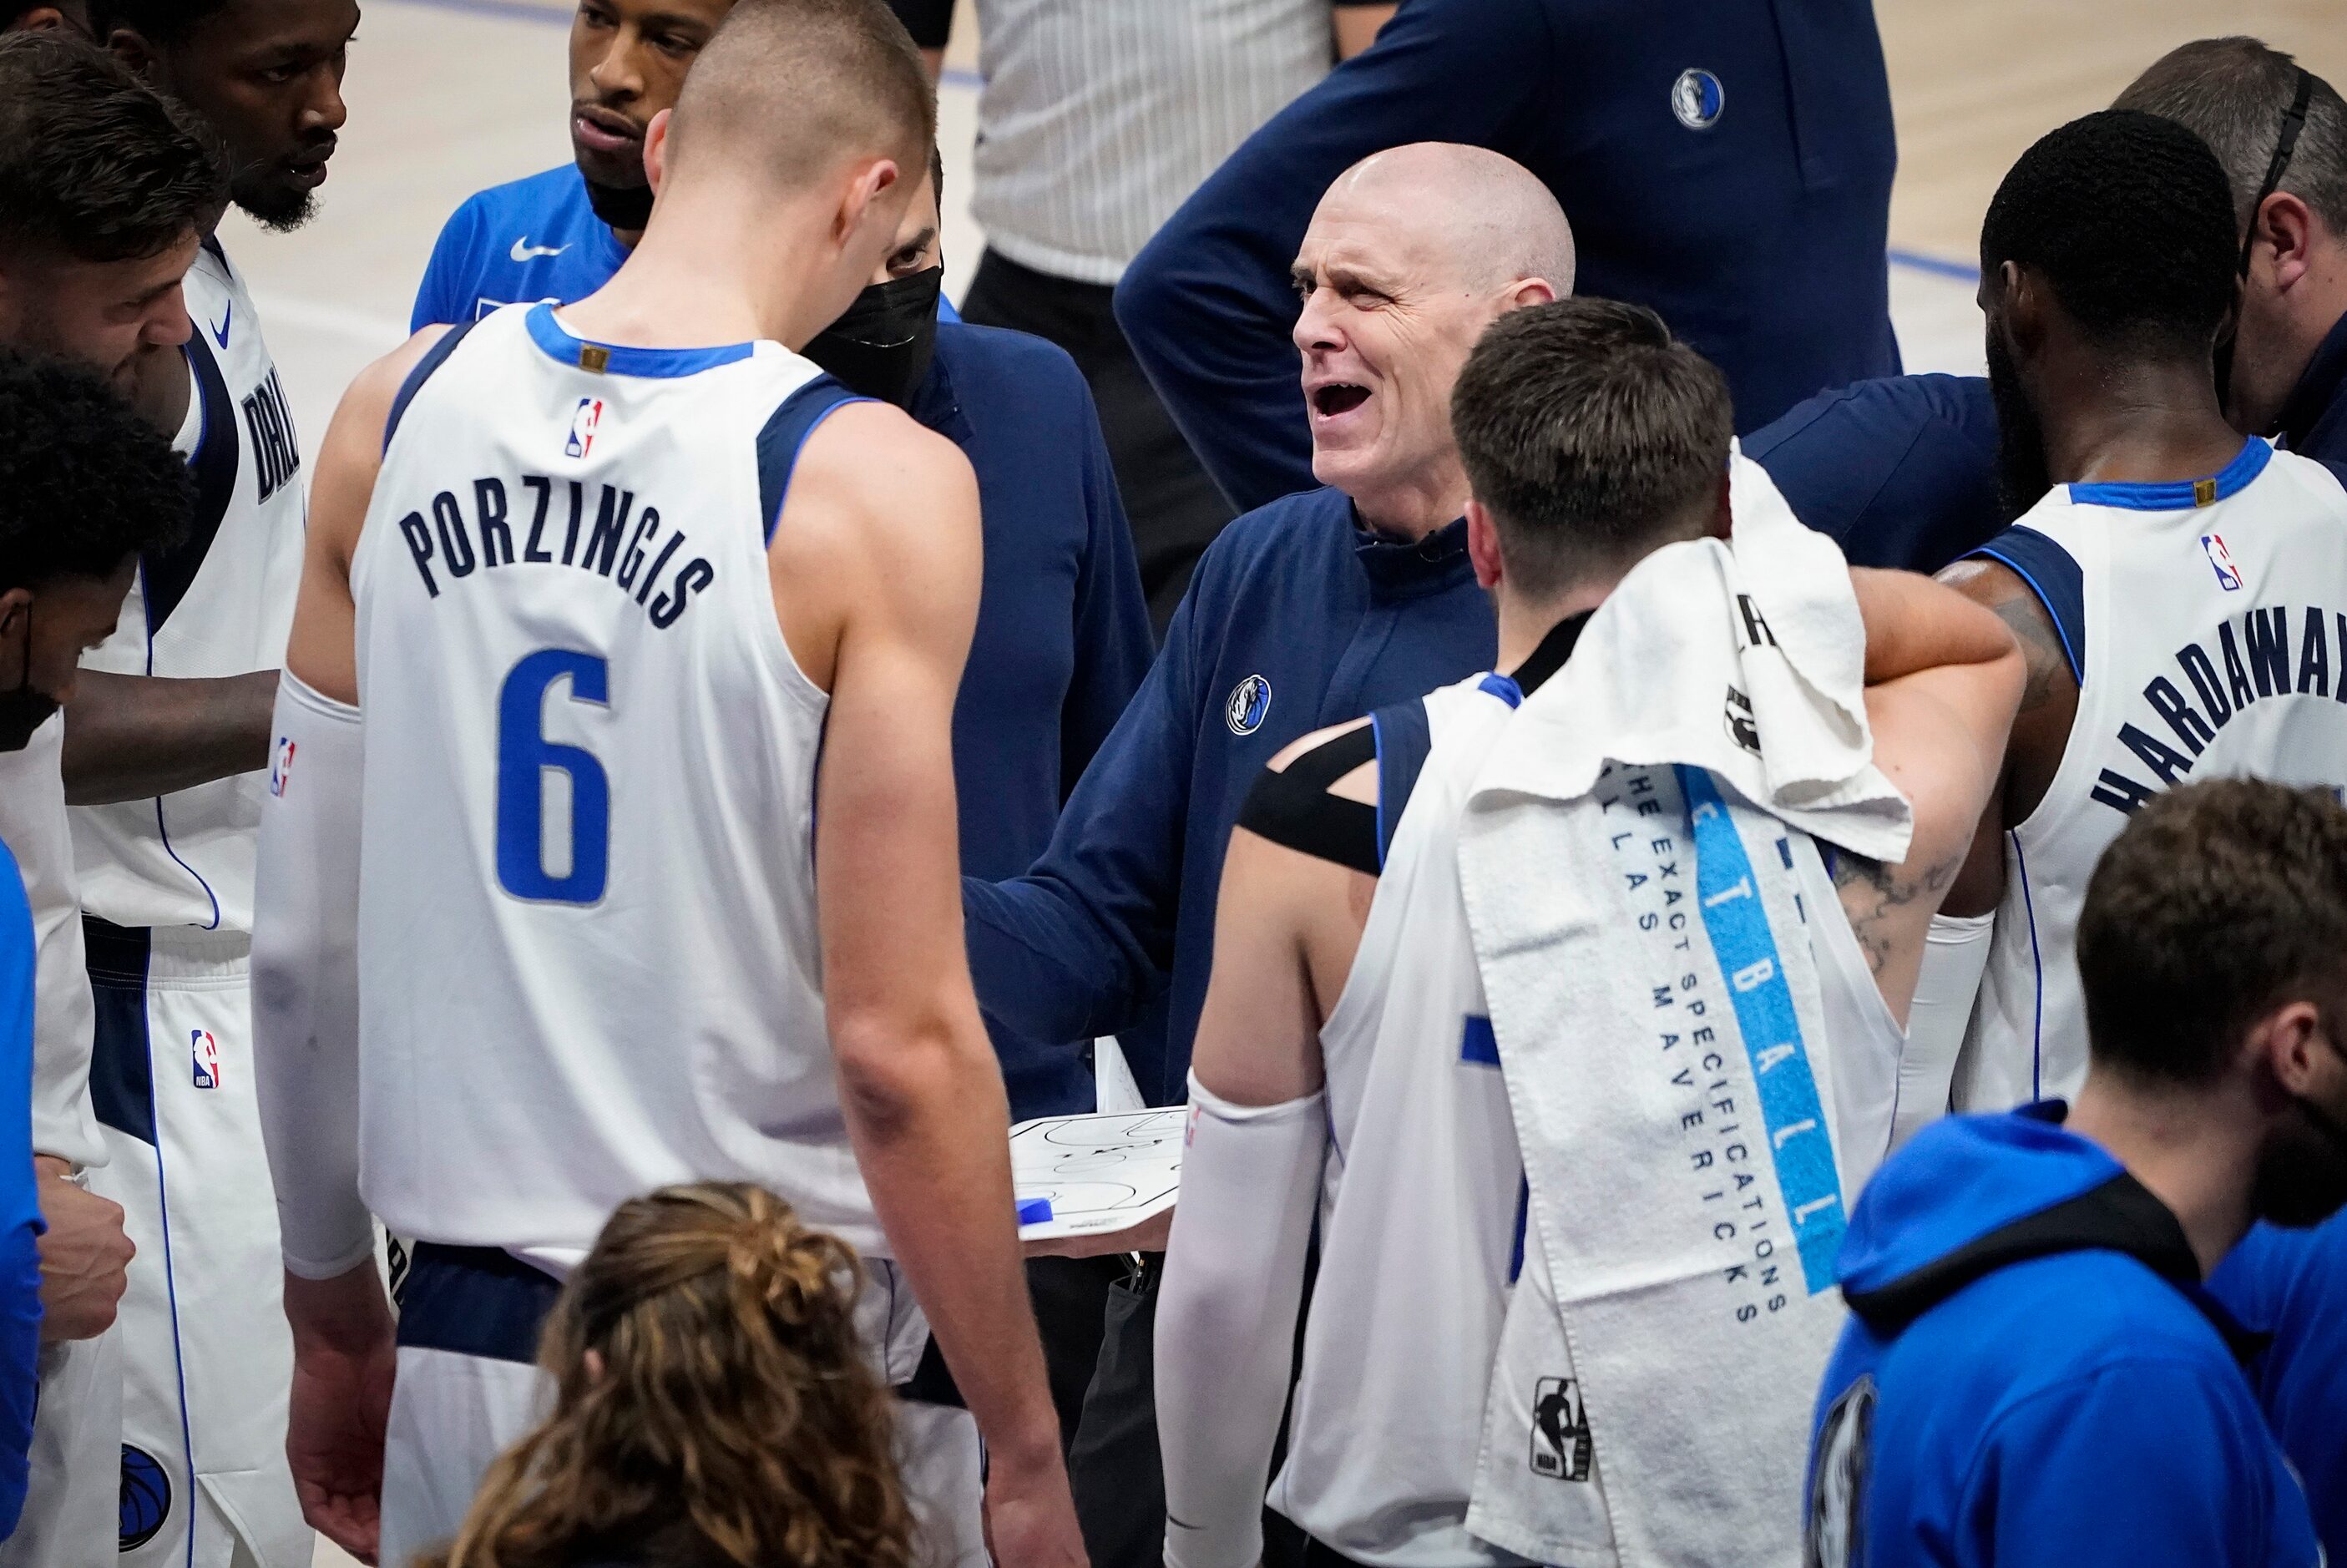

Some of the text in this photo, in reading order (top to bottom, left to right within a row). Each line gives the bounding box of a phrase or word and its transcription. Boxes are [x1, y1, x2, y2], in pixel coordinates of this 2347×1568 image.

[399, 474, 715, 630] PORZINGIS
[494, 647, 611, 909] 6
[2090, 605, 2347, 815] HARDAWA
[195, 1075, 210, 1086] NBA
[1623, 764, 1787, 1313] HE EXACT SPECIFICATIONS
[1652, 985, 1758, 1323] MAVERICKS
